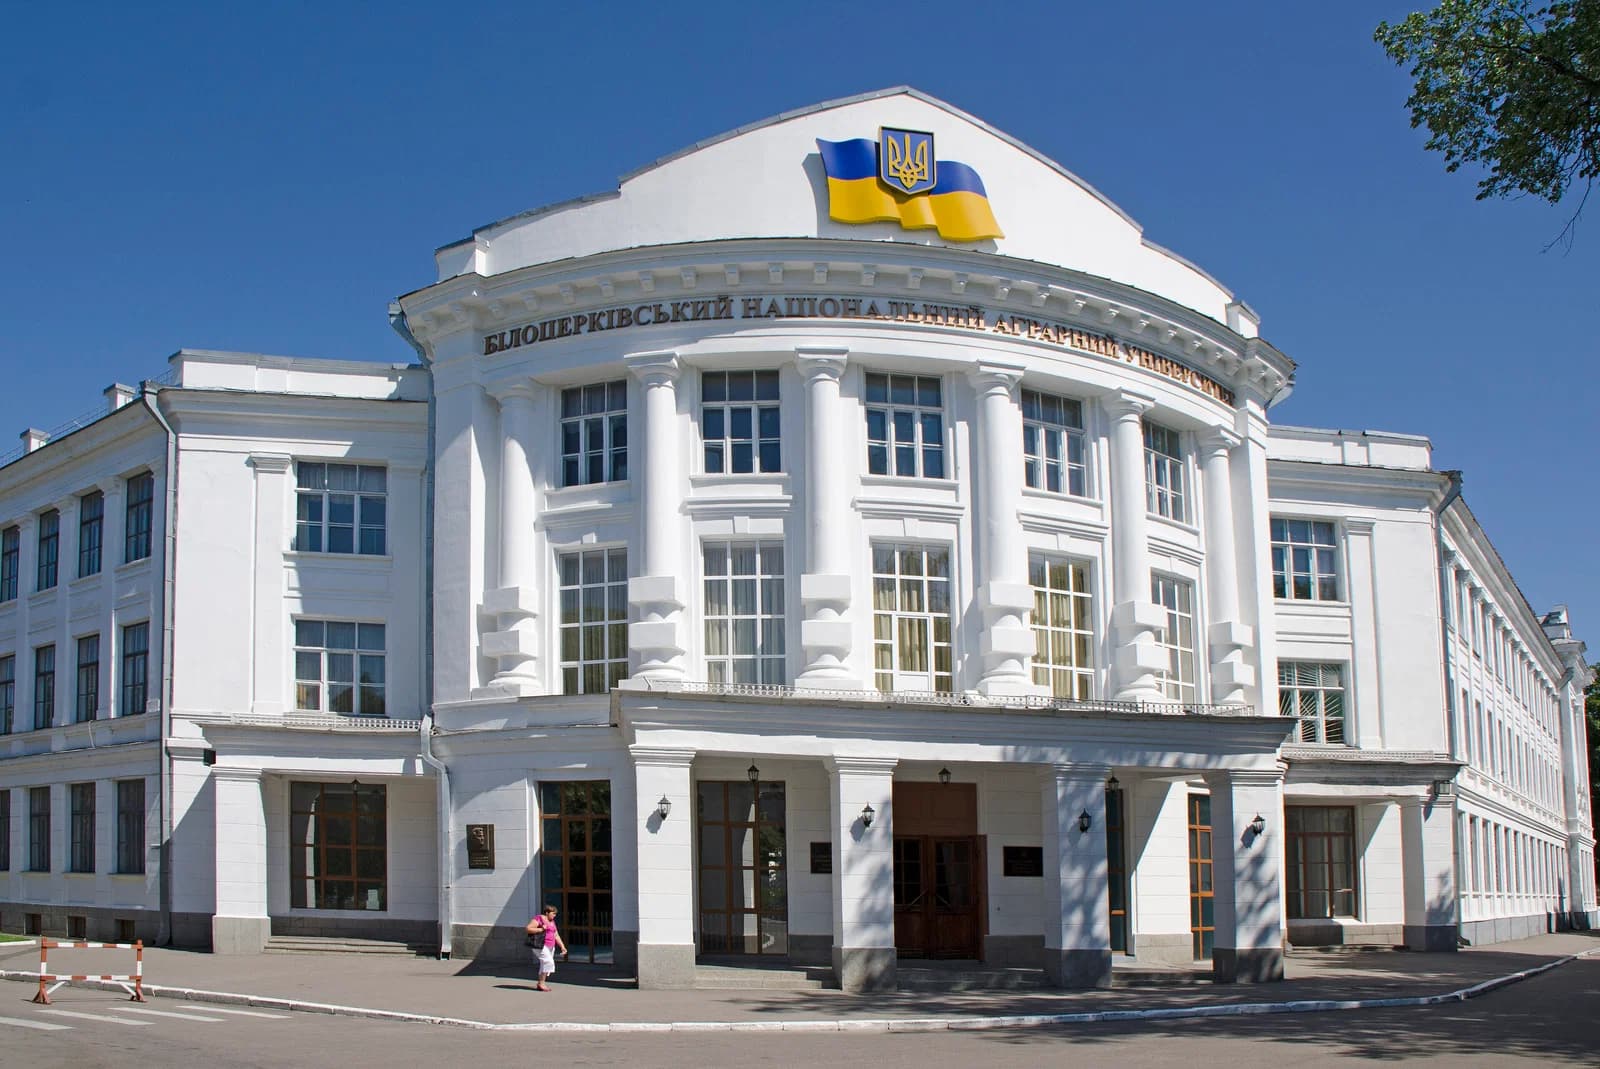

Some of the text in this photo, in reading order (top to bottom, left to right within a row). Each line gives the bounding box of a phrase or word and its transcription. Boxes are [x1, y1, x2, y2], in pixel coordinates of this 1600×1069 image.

[483, 295, 734, 355] БІЛОЦЕРКІВСЬКИЙ
[741, 297, 986, 331] НАЦІОНАЛЬНИЙ
[993, 314, 1121, 359] АГРАРНИЙ
